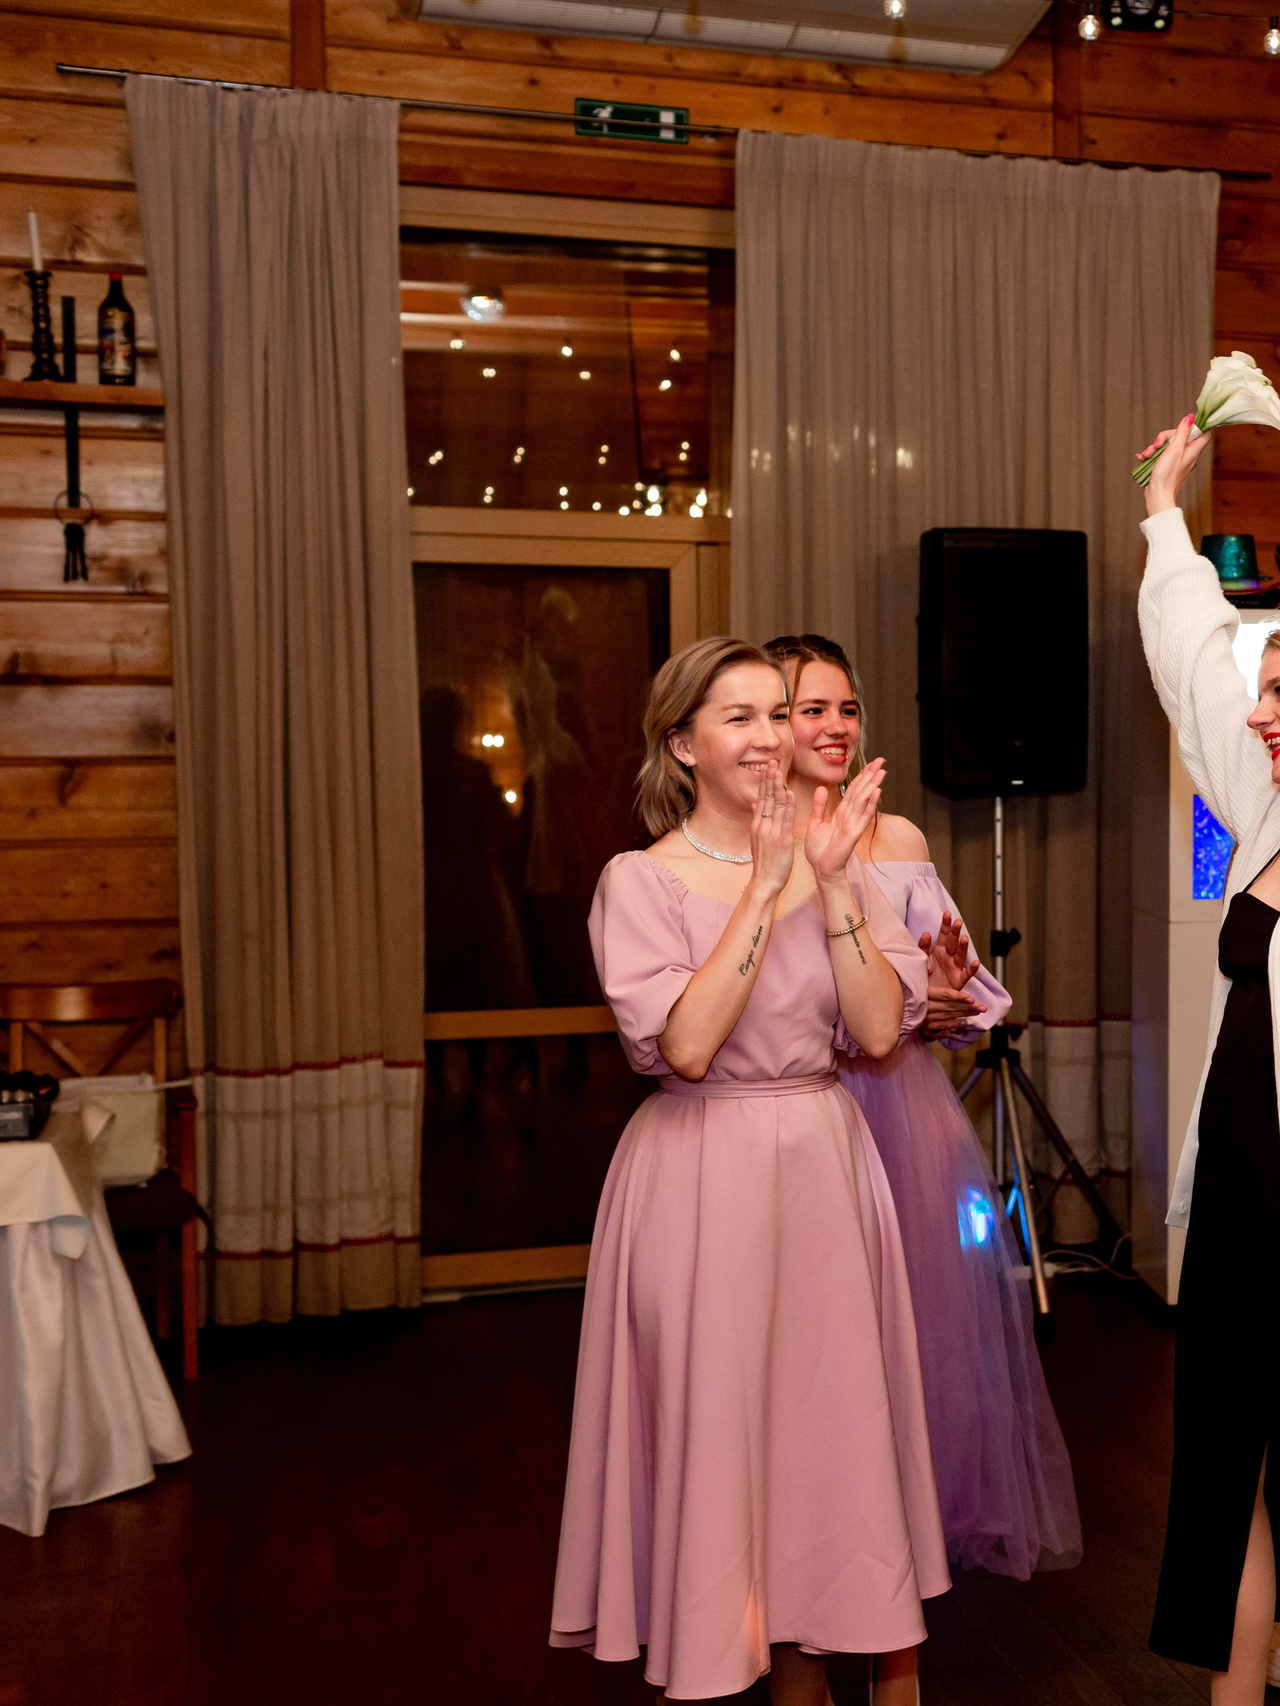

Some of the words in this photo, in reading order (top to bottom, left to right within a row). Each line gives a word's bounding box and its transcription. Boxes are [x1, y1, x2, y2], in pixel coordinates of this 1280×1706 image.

[739, 949, 755, 976] Carpe
[752, 925, 763, 948] diem
[858, 949, 868, 965] mori
